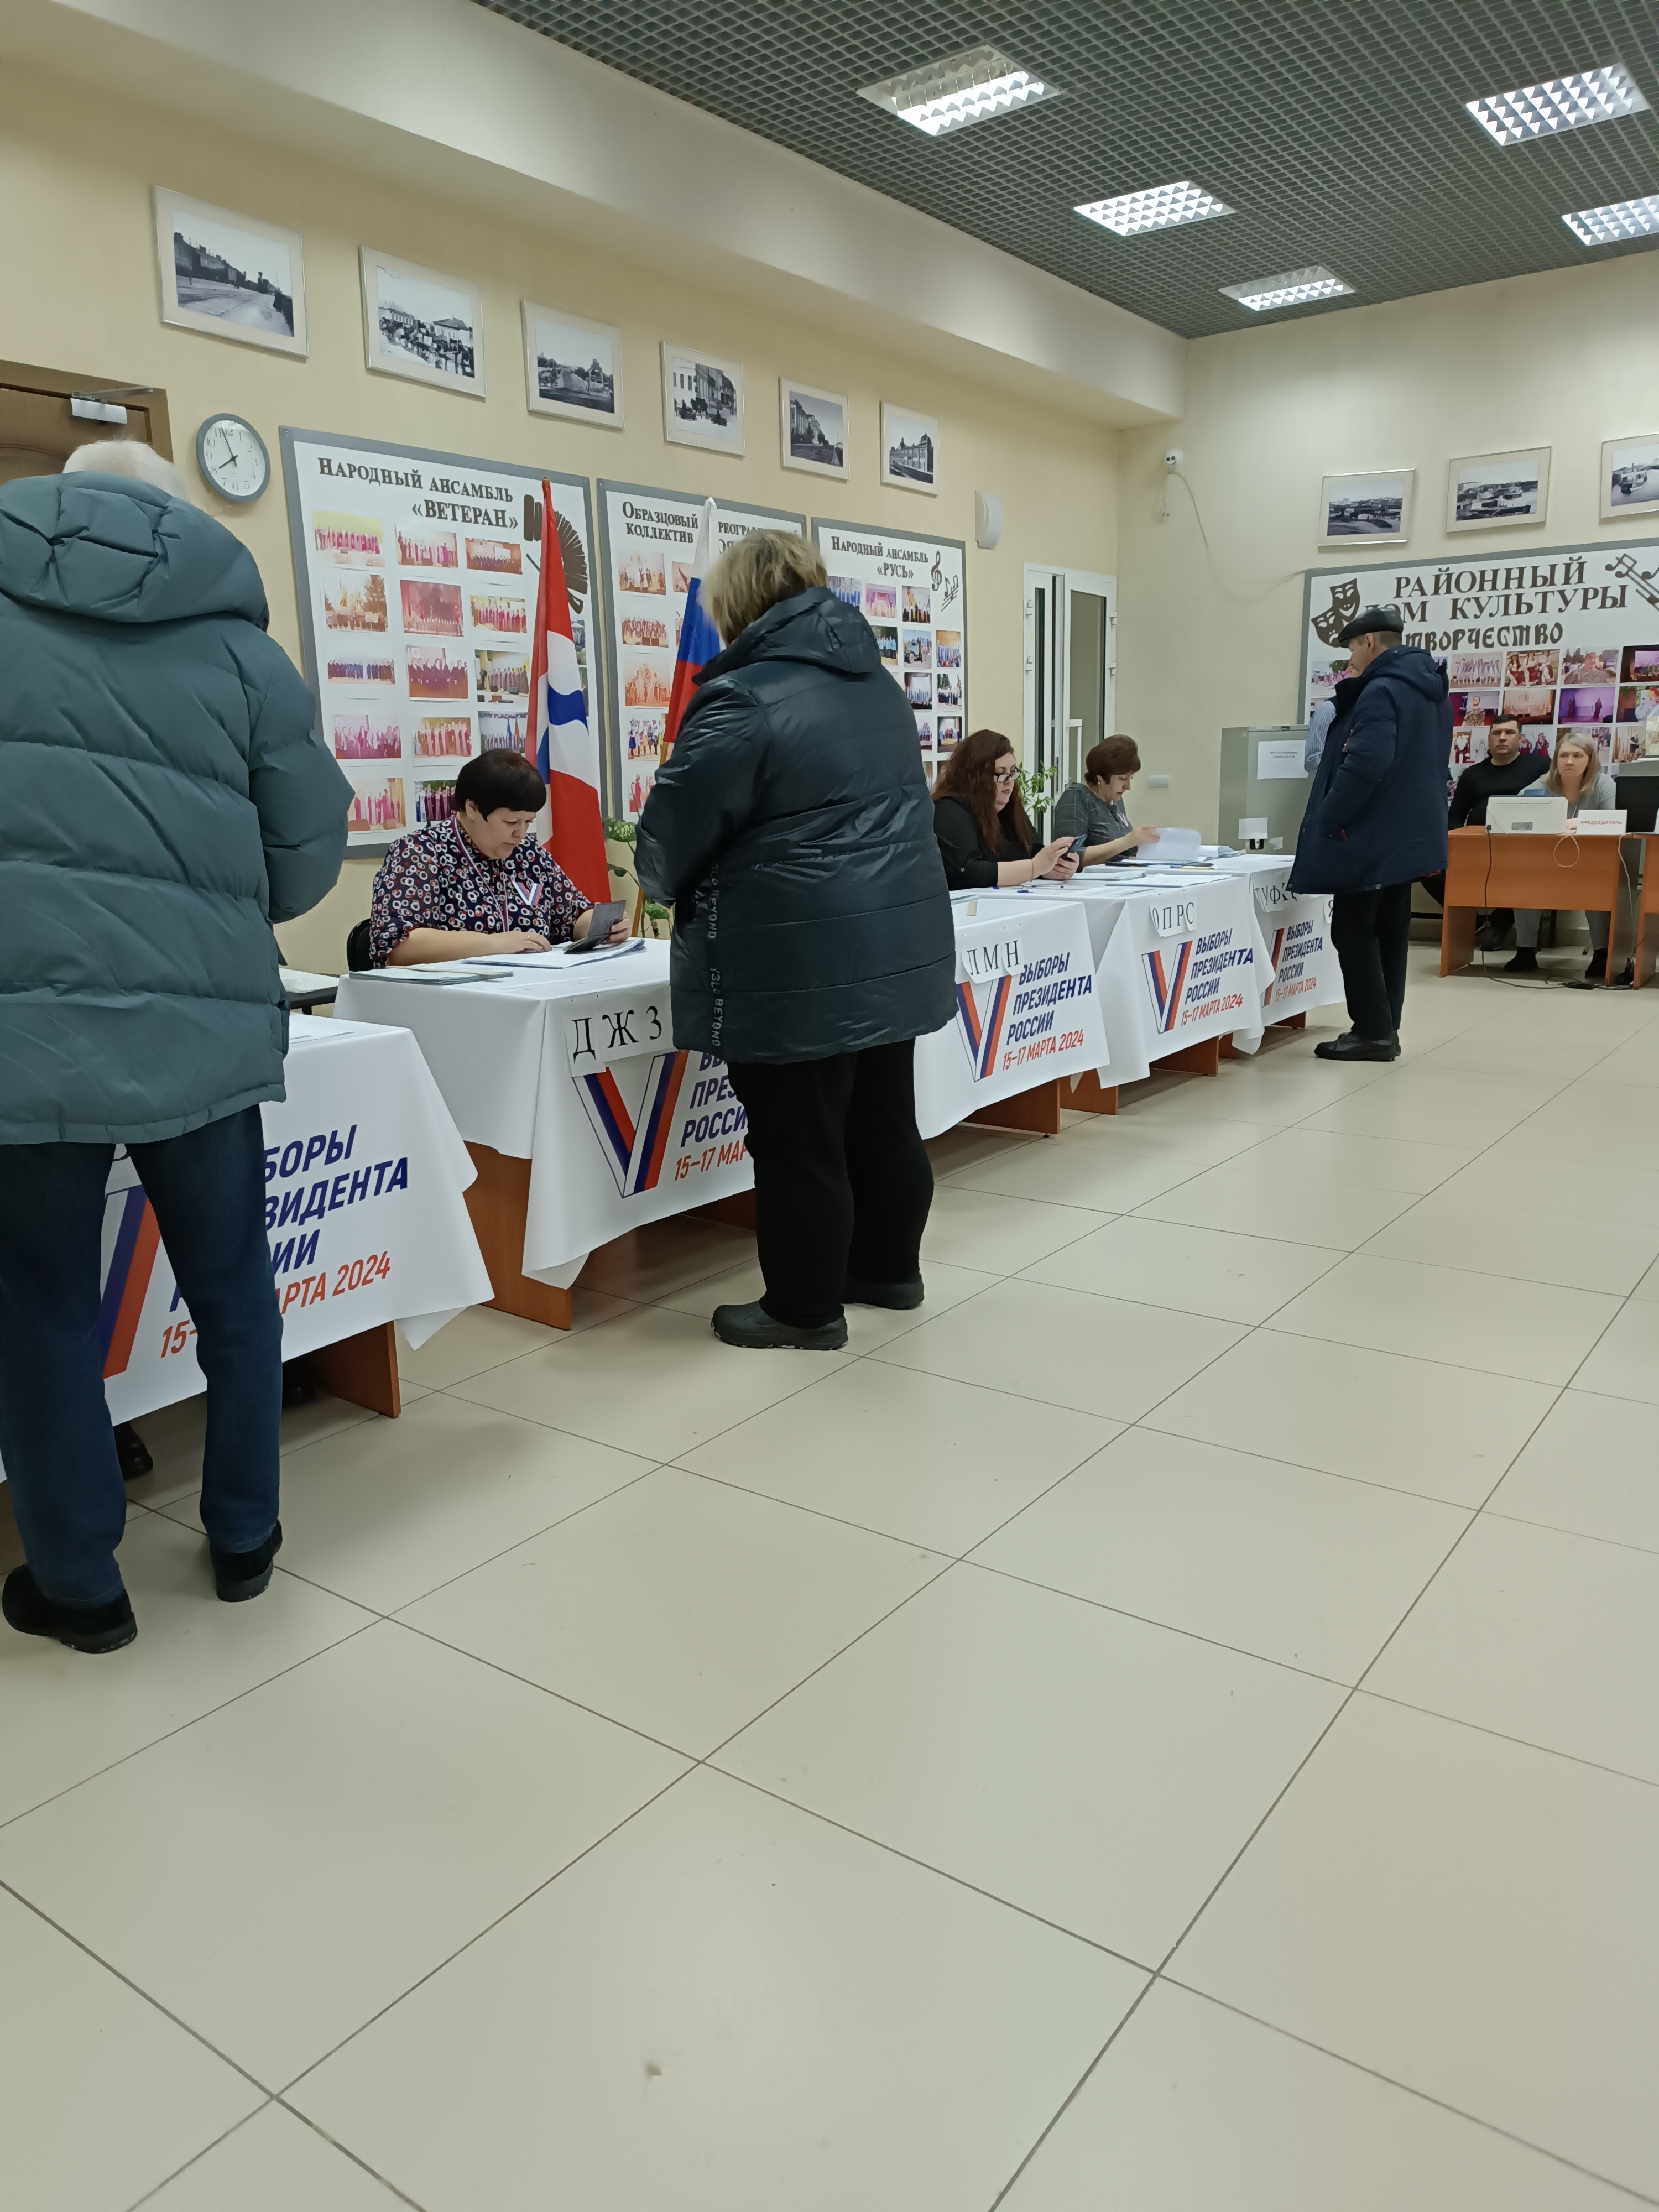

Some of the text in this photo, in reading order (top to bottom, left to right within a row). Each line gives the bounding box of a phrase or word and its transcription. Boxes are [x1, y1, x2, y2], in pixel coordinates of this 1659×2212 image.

[207, 437, 215, 447] 10
[215, 428, 221, 437] 11
[206, 451, 212, 460] 9
[247, 444, 252, 452] 2
[252, 457, 258, 466] 3
[211, 466, 217, 474] 8
[251, 471, 256, 479] 4
[317, 457, 513, 502] НАРОДНЫЙ АНСАМБЛЬ
[232, 483, 239, 491] 6
[244, 481, 250, 489] 5
[412, 499, 518, 529] «ВЕТЕРАН»
[623, 502, 699, 529] ОБРАЗЦОВЫЙ
[625, 523, 693, 544] КОЛЛЕКТИВ
[831, 536, 928, 563] НАРОДНЫЙ АНСАМБЛЬ
[877, 562, 914, 579] «РУСЬ»
[1393, 555, 1587, 599] РАЙОННЫЙ
[1449, 584, 1629, 620] КУЛЬТУРЫ
[1196, 928, 1233, 955] ВЫБОРЫ
[1286, 920, 1314, 941] ВЫБОРЫ
[1282, 937, 1323, 962] ПРЕЗИДЕНТА
[1019, 952, 1070, 985] ВЫБОРЫ
[1191, 948, 1253, 980] ПРЕЗИДЕНТА
[1278, 962, 1304, 983] РОССИИ
[1013, 974, 1091, 1015] ПРЕЗИДЕНТА
[1185, 977, 1220, 1005] РОССИИ
[1288, 980, 1304, 998] МАРТА
[1305, 977, 1317, 992] 2024
[1199, 1000, 1220, 1019] МАРТА
[1221, 993, 1243, 1011] 2024
[712, 998, 723, 1046] BEYOND
[1006, 1010, 1055, 1045] РОССИИ
[1026, 1036, 1056, 1062] МАРТА
[1058, 1029, 1084, 1051] 2024
[681, 1106, 747, 1148] РОССИ
[264, 1124, 357, 1183] БОРЫ
[717, 1140, 748, 1167] МАР
[265, 1157, 408, 1232] ЗИДЕНТА
[332, 1251, 390, 1297] 2024
